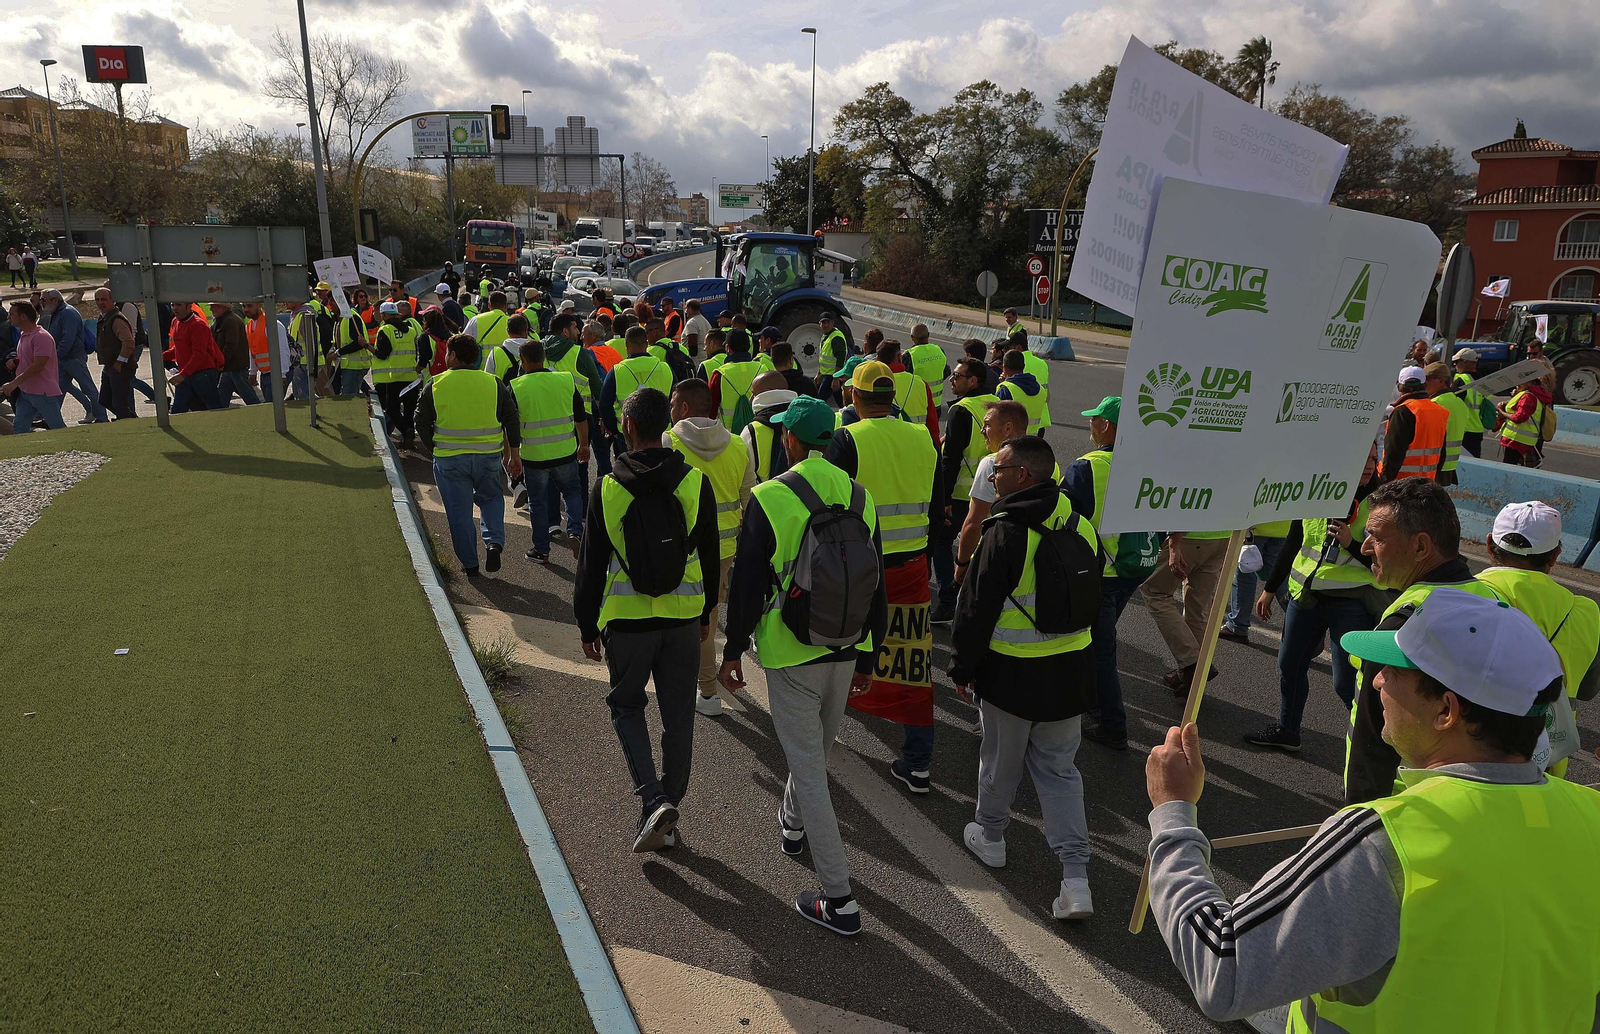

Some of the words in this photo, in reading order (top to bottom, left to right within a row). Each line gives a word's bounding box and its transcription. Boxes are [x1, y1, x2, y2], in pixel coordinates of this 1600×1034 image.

[1046, 212, 1084, 226] HOTE
[1163, 256, 1266, 293] COAG
[1038, 287, 1049, 295] STOP
[1168, 289, 1202, 309] Cádiz
[1325, 322, 1362, 340] ASAJA
[1200, 366, 1252, 393] UPA
[1299, 382, 1360, 397] cooperativas
[1194, 399, 1211, 408] Unión
[1221, 401, 1248, 410] Pequeños
[1295, 396, 1376, 412] agro-alimentarias
[1192, 407, 1247, 418] AGRICULTORES
[1291, 412, 1320, 422] Andalucía
[1351, 415, 1370, 425] Cádiz
[1198, 416, 1244, 426] GANADEROS
[1134, 477, 1177, 510] Por
[1180, 486, 1213, 510] un
[1253, 477, 1304, 510] Campo
[1307, 472, 1348, 500] Vivo
